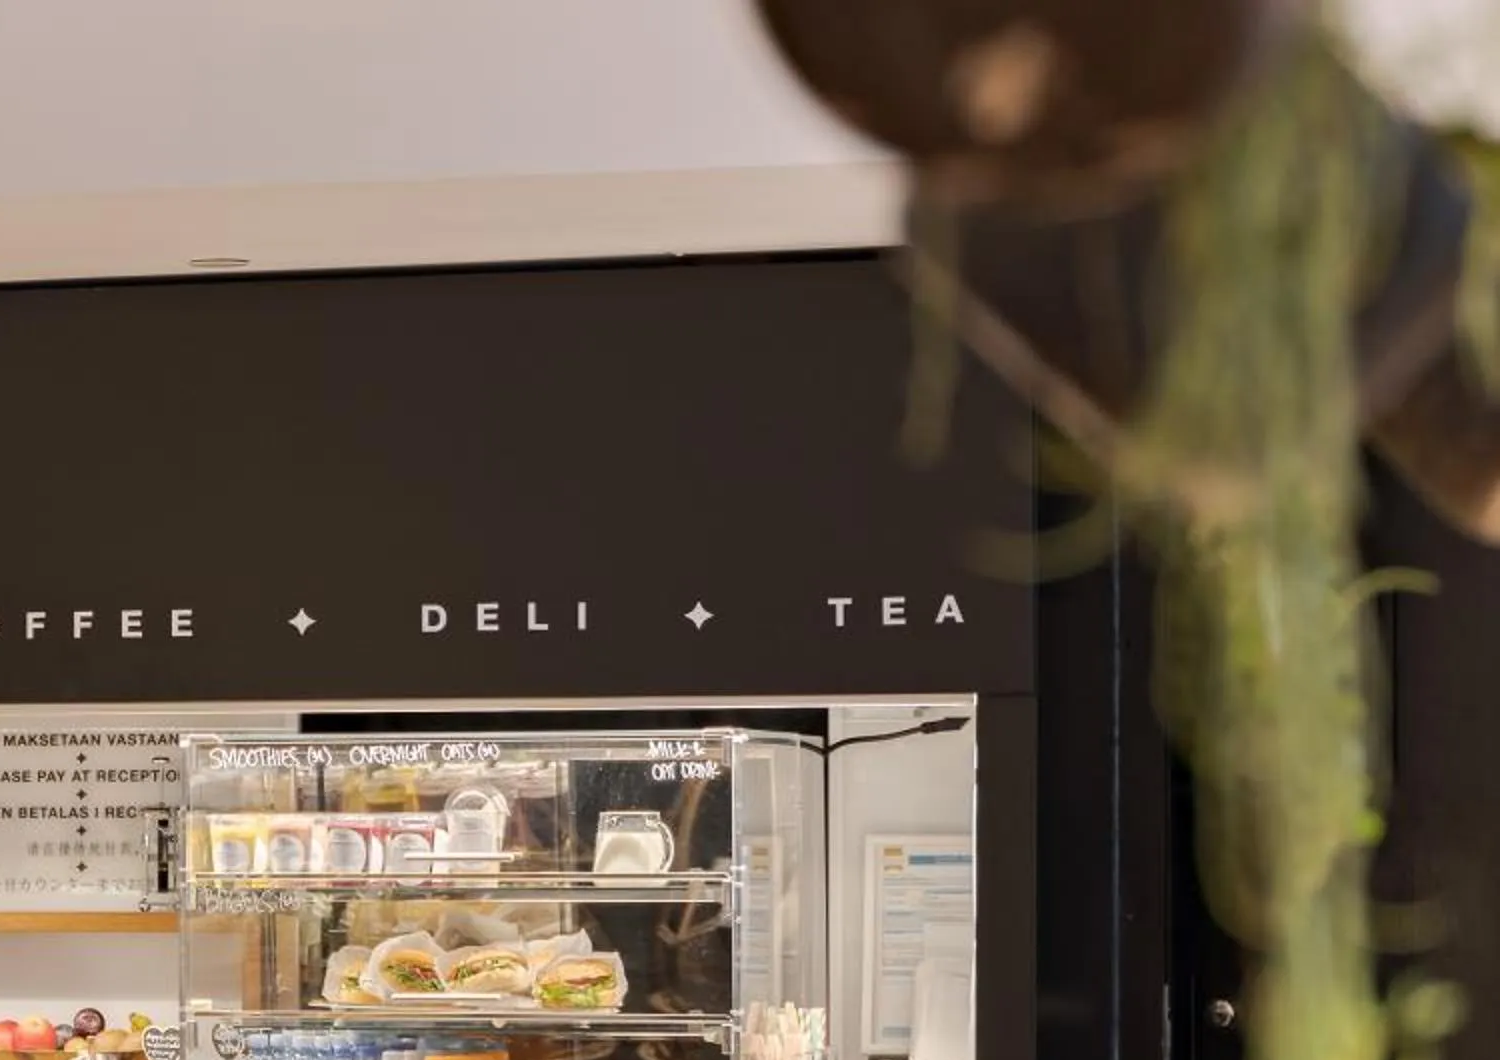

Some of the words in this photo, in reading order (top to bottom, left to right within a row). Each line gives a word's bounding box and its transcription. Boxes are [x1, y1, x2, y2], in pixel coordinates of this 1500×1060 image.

[420, 601, 588, 634] DELI
[827, 593, 965, 628] TEA
[2, 733, 102, 748] MAKSETAAN
[209, 746, 301, 770] SMOOTHIES
[348, 743, 431, 765] OVERNIGHT
[36, 769, 66, 783] PAY
[71, 769, 92, 783] AT
[96, 768, 181, 783] RECEPTIO
[18, 805, 90, 819] BETALAS
[94, 806, 99, 819] I
